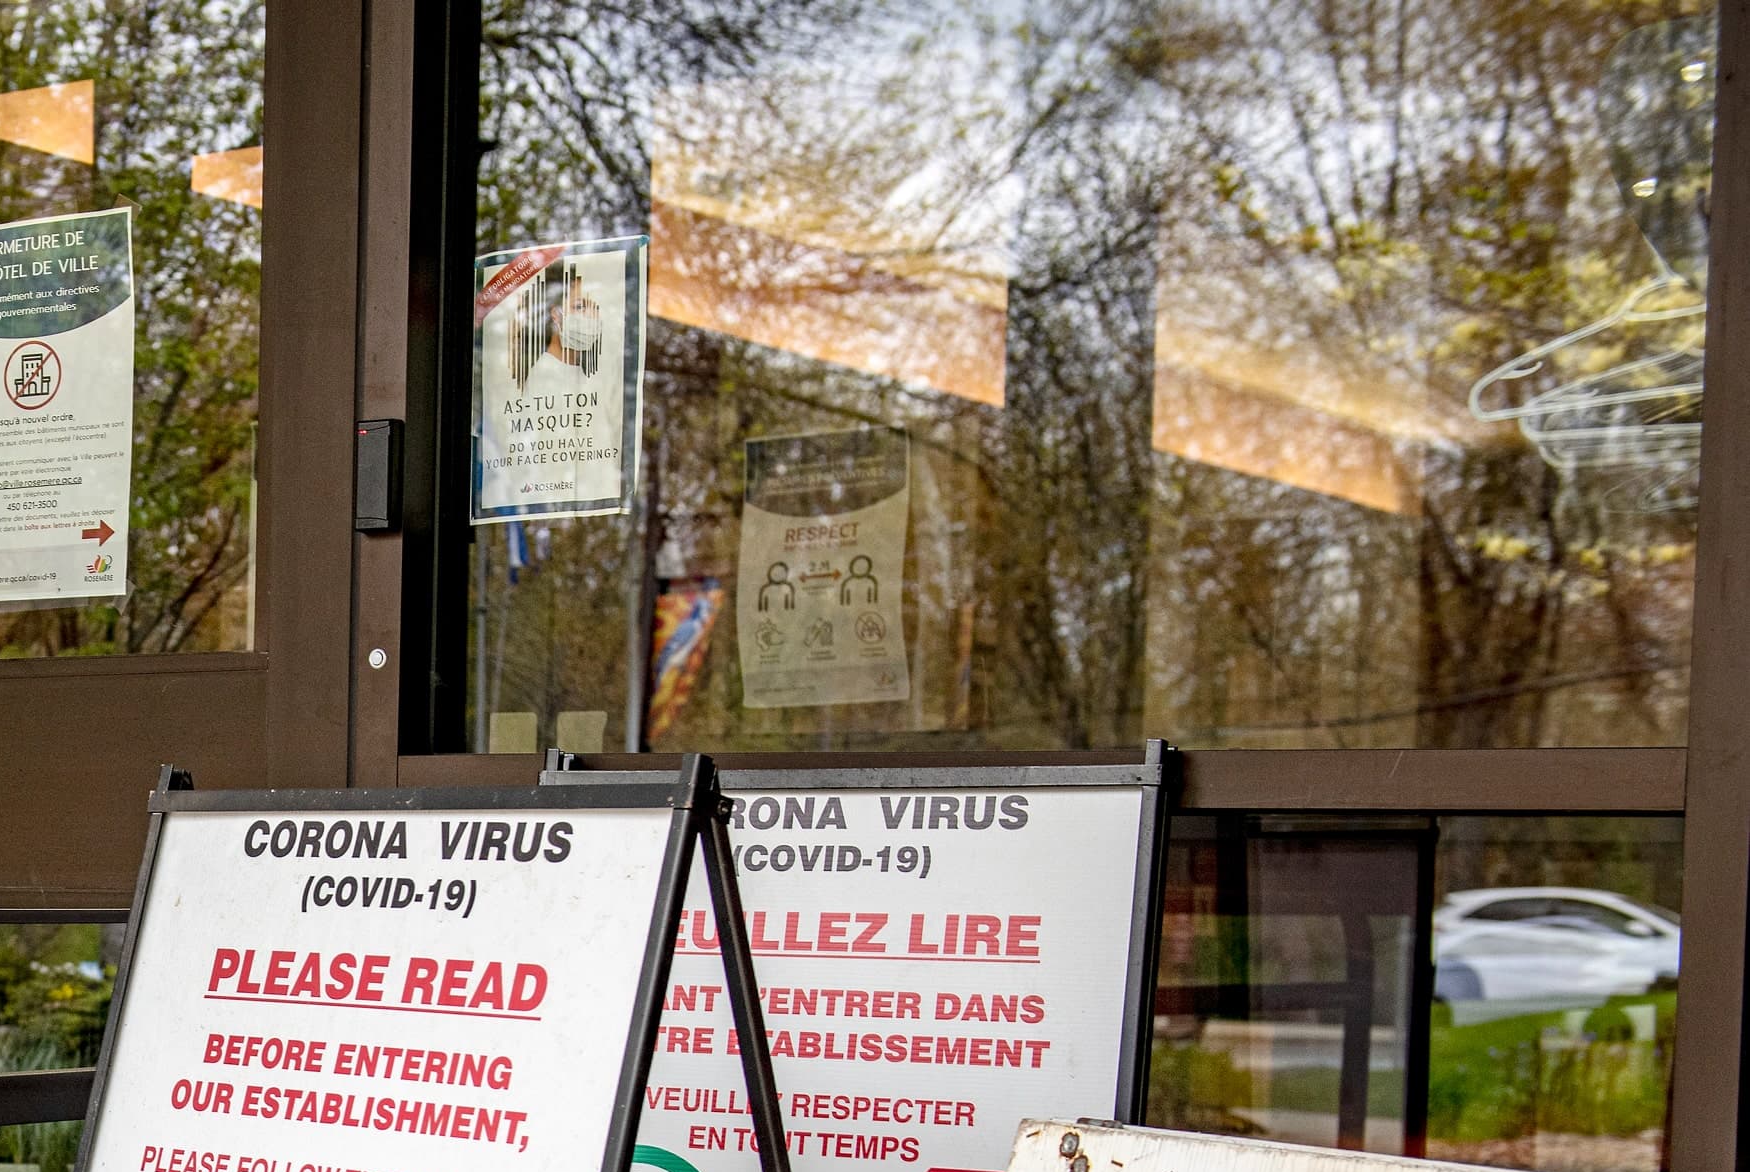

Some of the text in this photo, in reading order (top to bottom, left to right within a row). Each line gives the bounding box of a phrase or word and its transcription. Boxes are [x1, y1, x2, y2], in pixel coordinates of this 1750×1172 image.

[65, 231, 84, 247] DE
[32, 261, 52, 276] DE
[58, 255, 98, 273] VILLE
[36, 289, 54, 299] aux
[56, 284, 100, 297] directives
[504, 392, 598, 414] AS-TU TON
[22, 414, 49, 424] nouvel
[511, 413, 593, 434] MASQUE?
[510, 438, 593, 454] DO YOU HAVE
[486, 448, 619, 470] YOUR FACE COVERING?
[534, 481, 574, 492] ROSEMÈRE
[7, 500, 58, 511] 450 621-3500
[785, 522, 860, 542] RESPECT
[84, 574, 114, 582] ROSEMÈRE
[880, 795, 1028, 830] VIRUS
[244, 820, 573, 862] CORONA VIRUS
[734, 845, 932, 880] (COVID-19)
[302, 876, 476, 918] (COVID-19)
[908, 914, 1042, 956] LIRE
[208, 948, 548, 1011] PLEASE READ
[935, 993, 1044, 1024] DANS
[204, 1034, 512, 1090] BEFORE ENTERING
[172, 1079, 528, 1152] OUR ESTABLISHMENT,
[791, 1094, 975, 1126] RESPECTER
[689, 1126, 919, 1162] EN TEMPS
